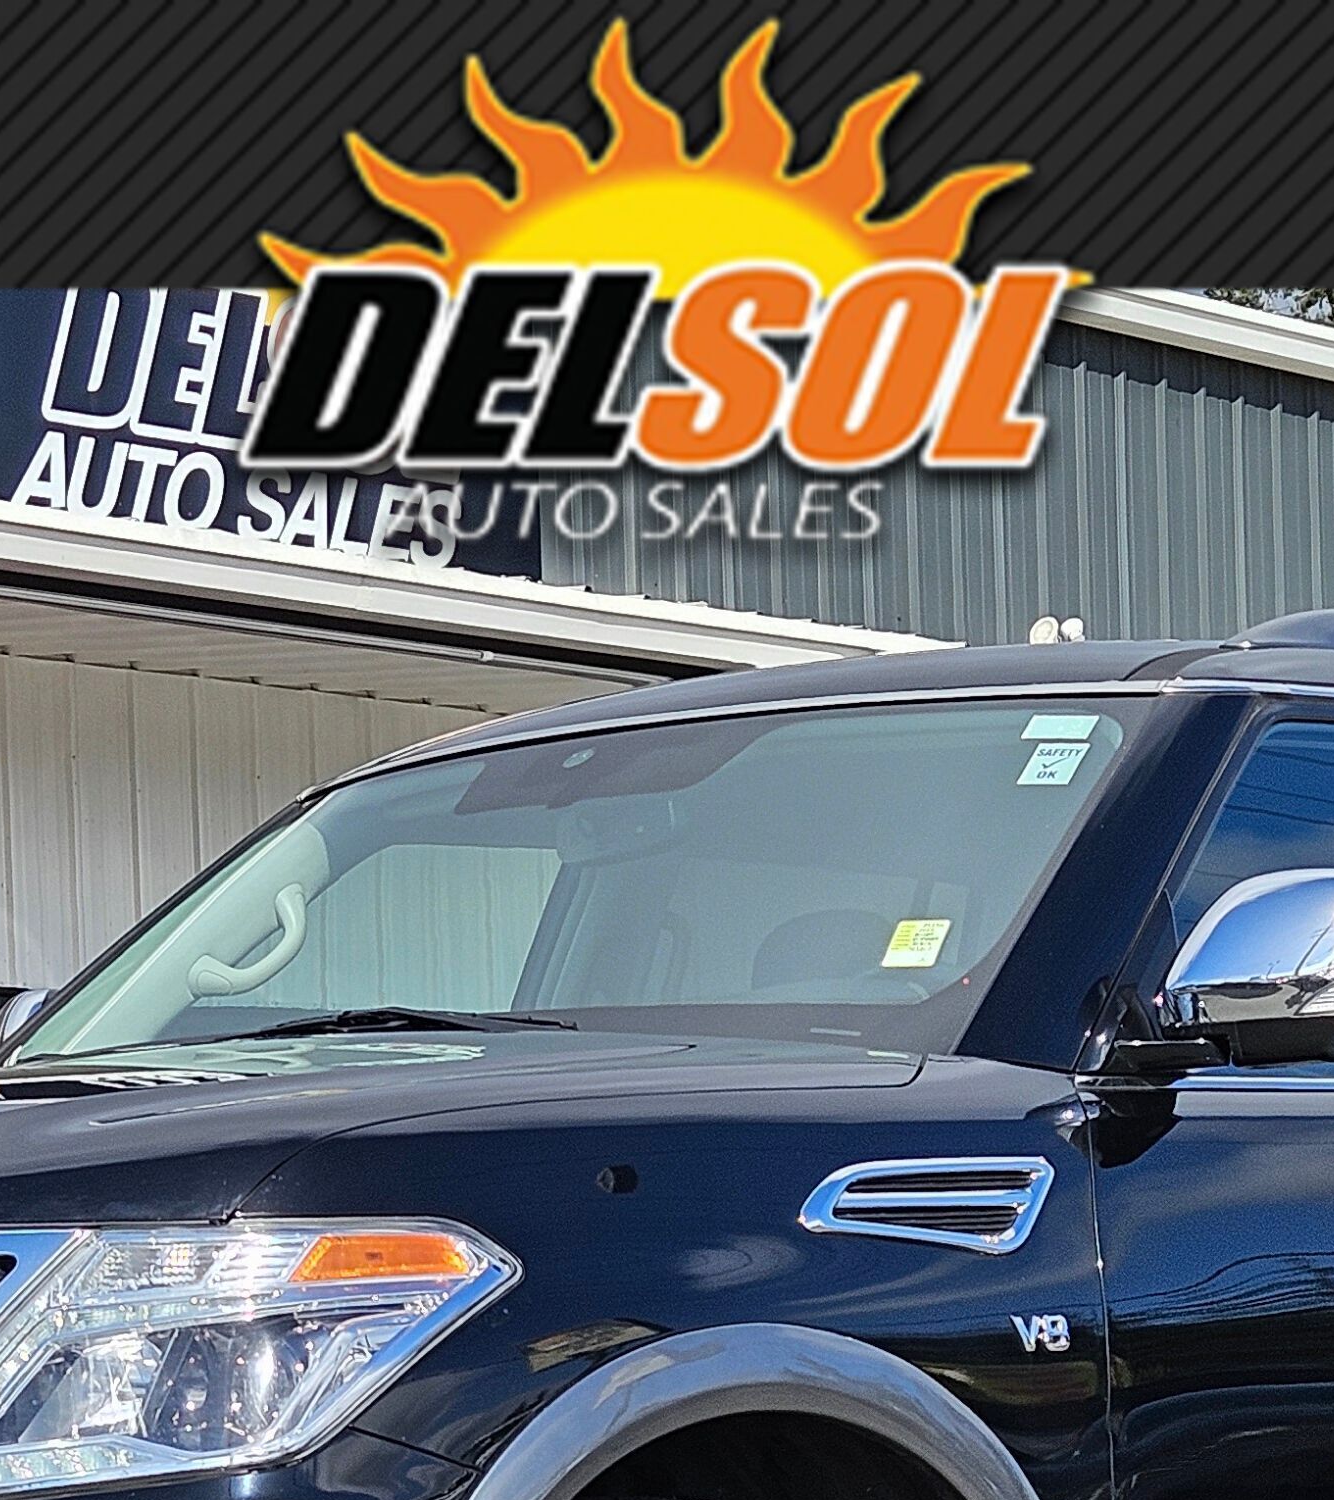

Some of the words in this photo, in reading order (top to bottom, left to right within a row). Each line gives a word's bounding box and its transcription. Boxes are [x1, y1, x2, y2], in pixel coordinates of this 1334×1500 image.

[41, 287, 292, 450] DEL
[12, 431, 224, 531] AUTO
[237, 467, 462, 569] SALES
[1037, 748, 1083, 757] SAFETY
[1036, 770, 1058, 779] OK
[1009, 1314, 1070, 1352] V8
